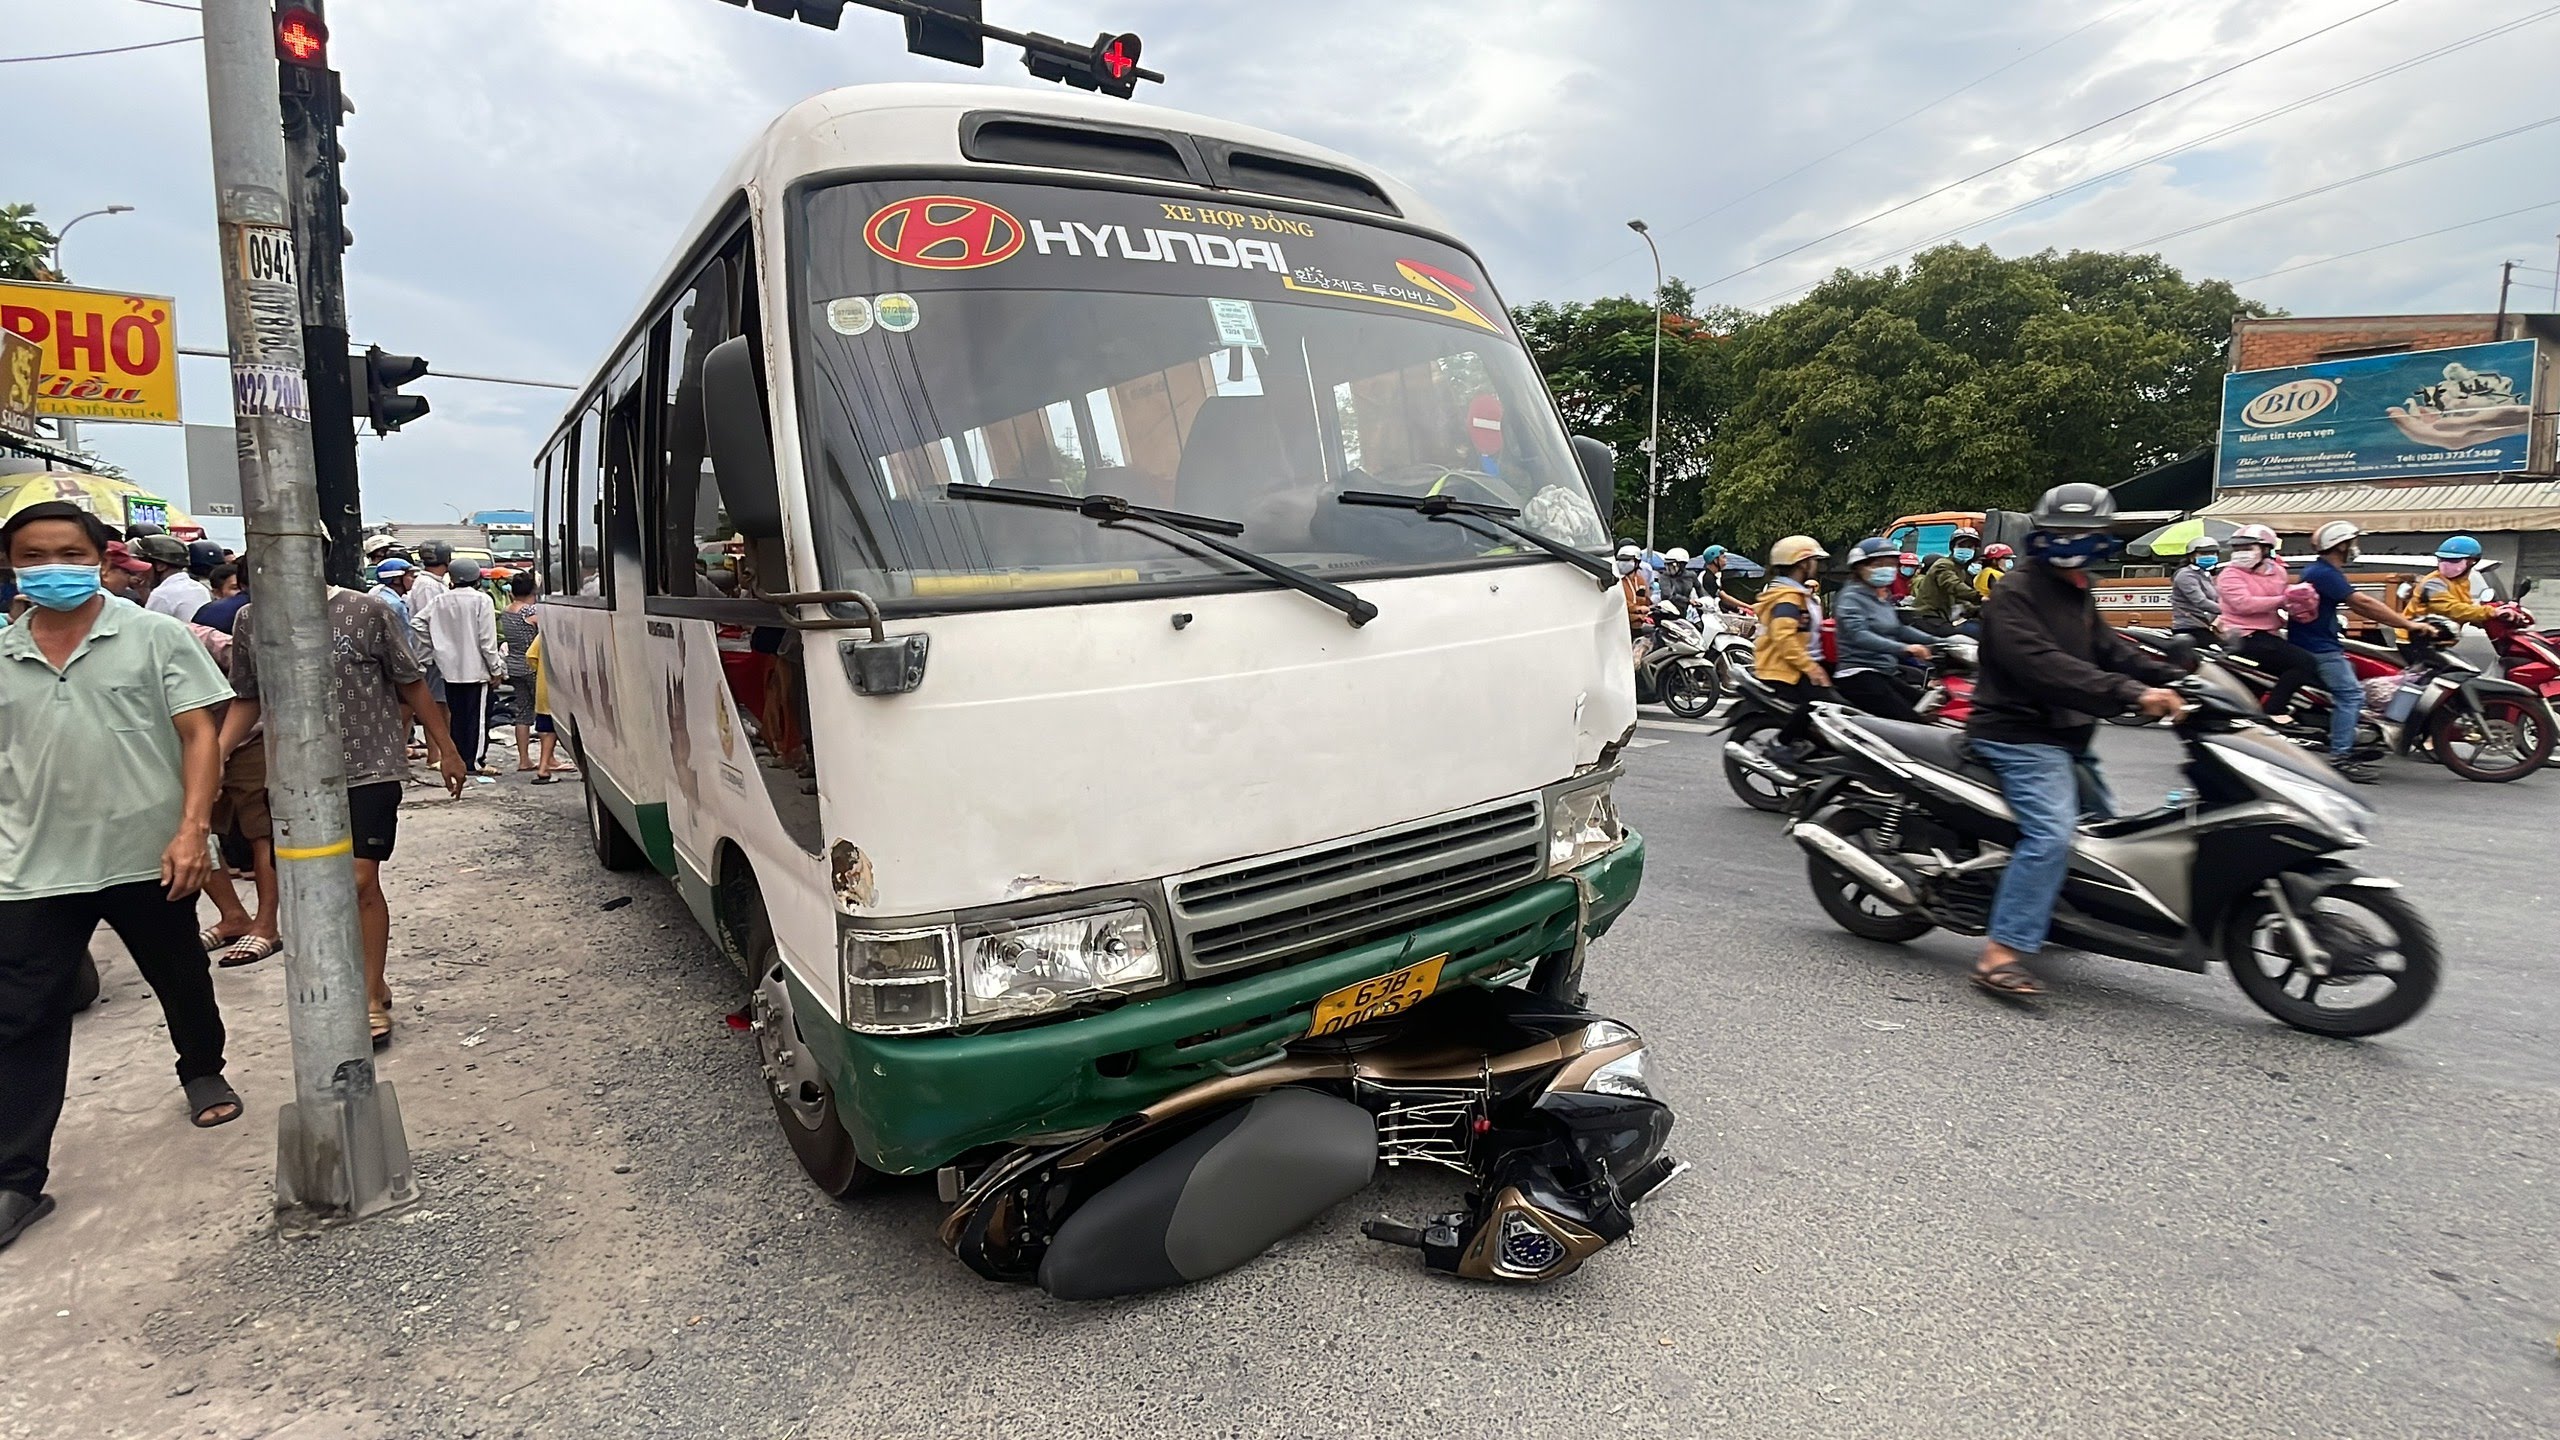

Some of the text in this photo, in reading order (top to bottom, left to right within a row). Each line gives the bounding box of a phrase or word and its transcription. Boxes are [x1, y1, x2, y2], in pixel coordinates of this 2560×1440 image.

[1160, 203, 1315, 237] XE HỢP ĐỒNG
[250, 234, 297, 284] 0942
[1029, 219, 1289, 274] HYUNDAI
[1372, 283, 1439, 306] 투어버스
[2269, 432, 2285, 440] tin
[2286, 430, 2311, 440] trọn
[1355, 971, 1411, 1007] 63B
